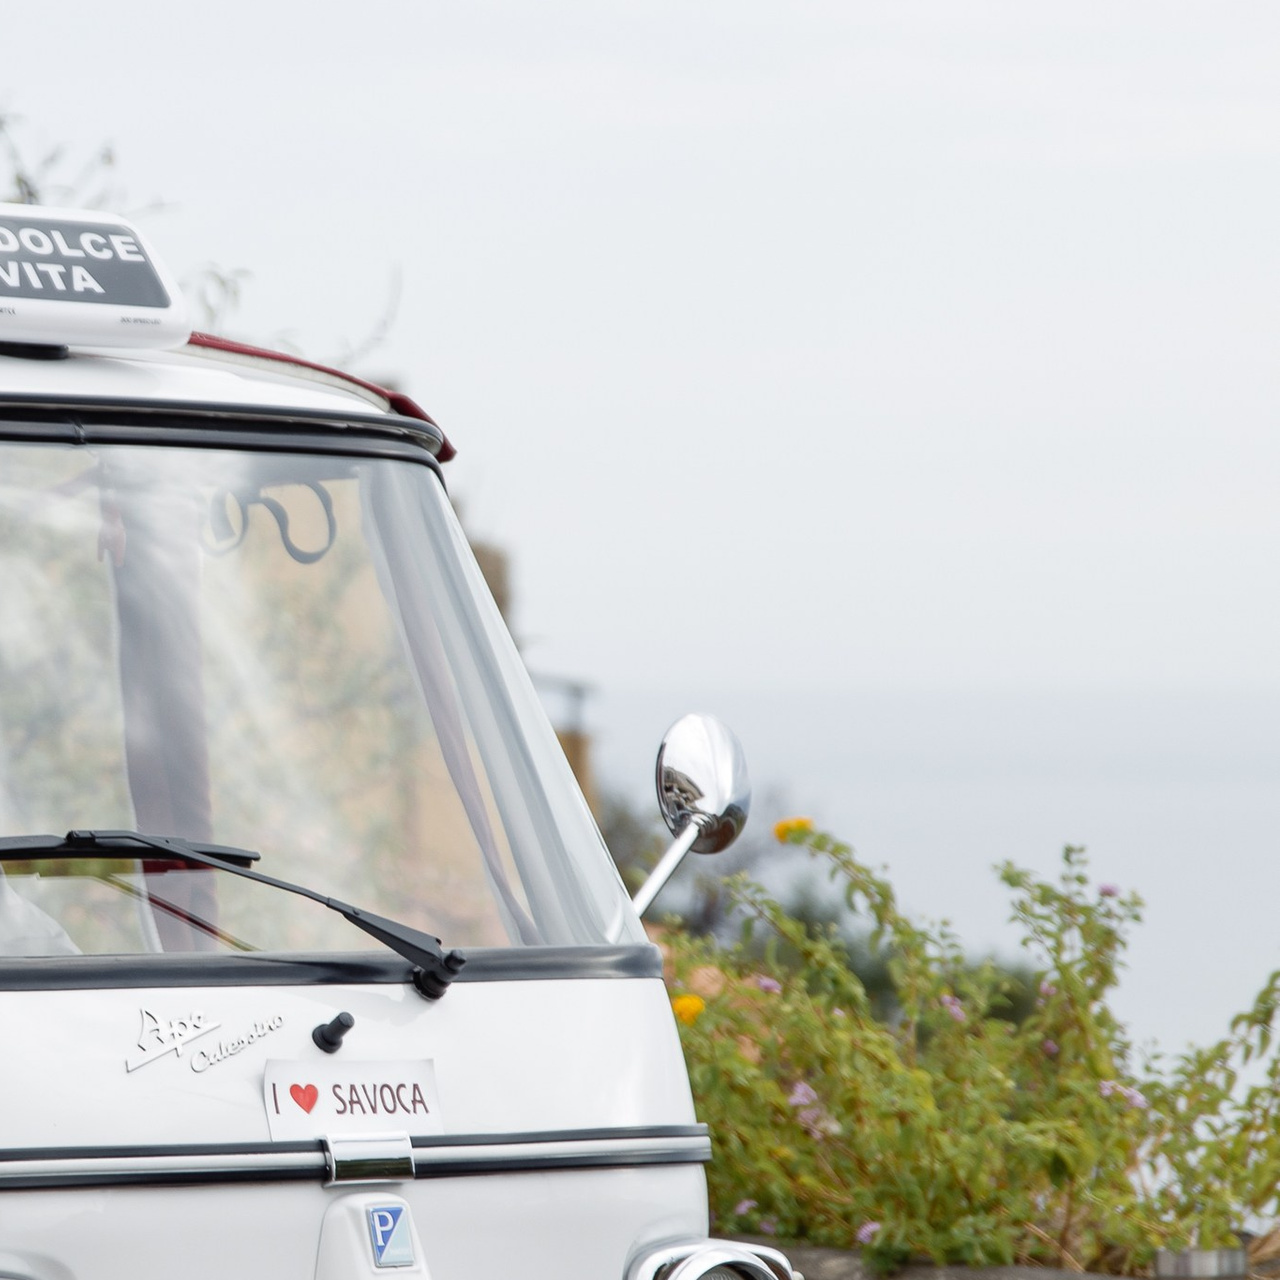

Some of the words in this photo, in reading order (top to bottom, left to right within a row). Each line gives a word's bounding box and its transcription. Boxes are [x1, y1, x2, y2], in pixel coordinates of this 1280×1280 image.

[271, 1082, 281, 1115] I
[331, 1082, 430, 1115] SAVOCA
[370, 1210, 395, 1247] P
